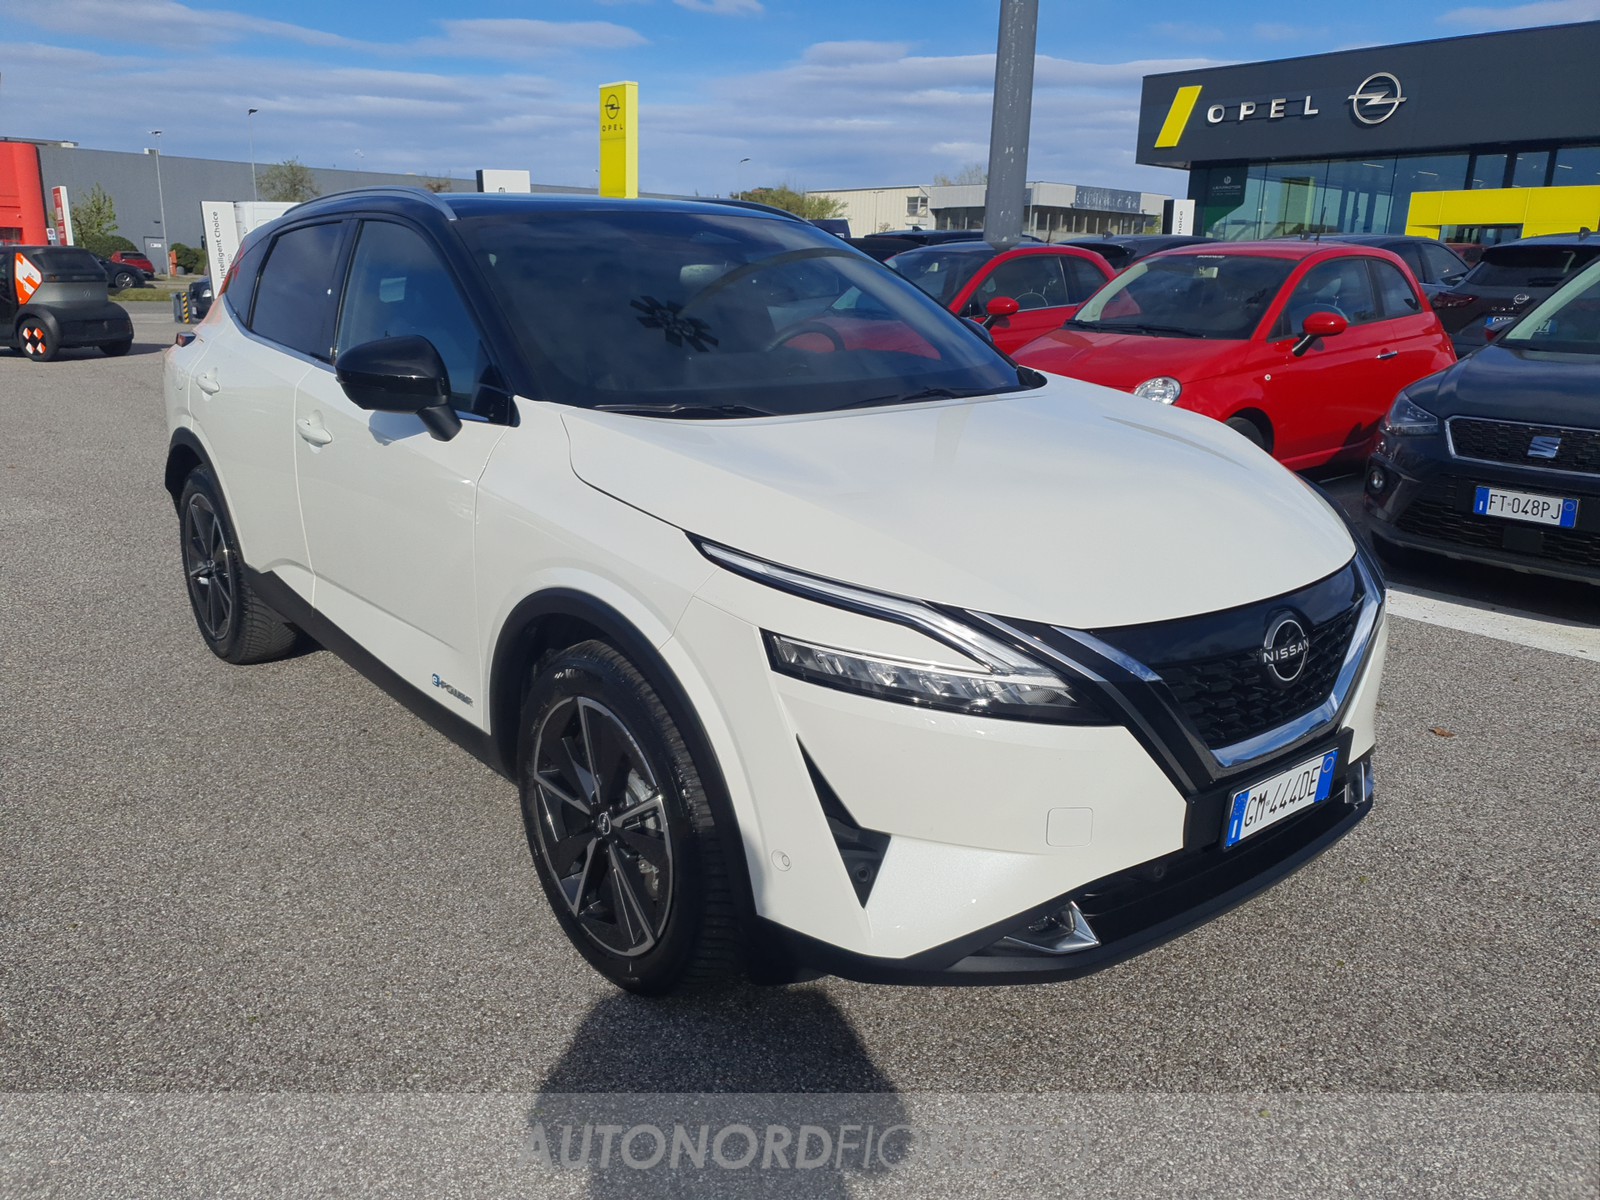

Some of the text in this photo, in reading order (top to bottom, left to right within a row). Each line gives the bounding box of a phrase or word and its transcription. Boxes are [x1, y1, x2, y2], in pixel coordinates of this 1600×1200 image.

[1207, 95, 1319, 124] OPEL
[602, 124, 623, 132] OPEL
[212, 211, 226, 278] Intelligent Choice
[1263, 639, 1309, 664] NISSAN
